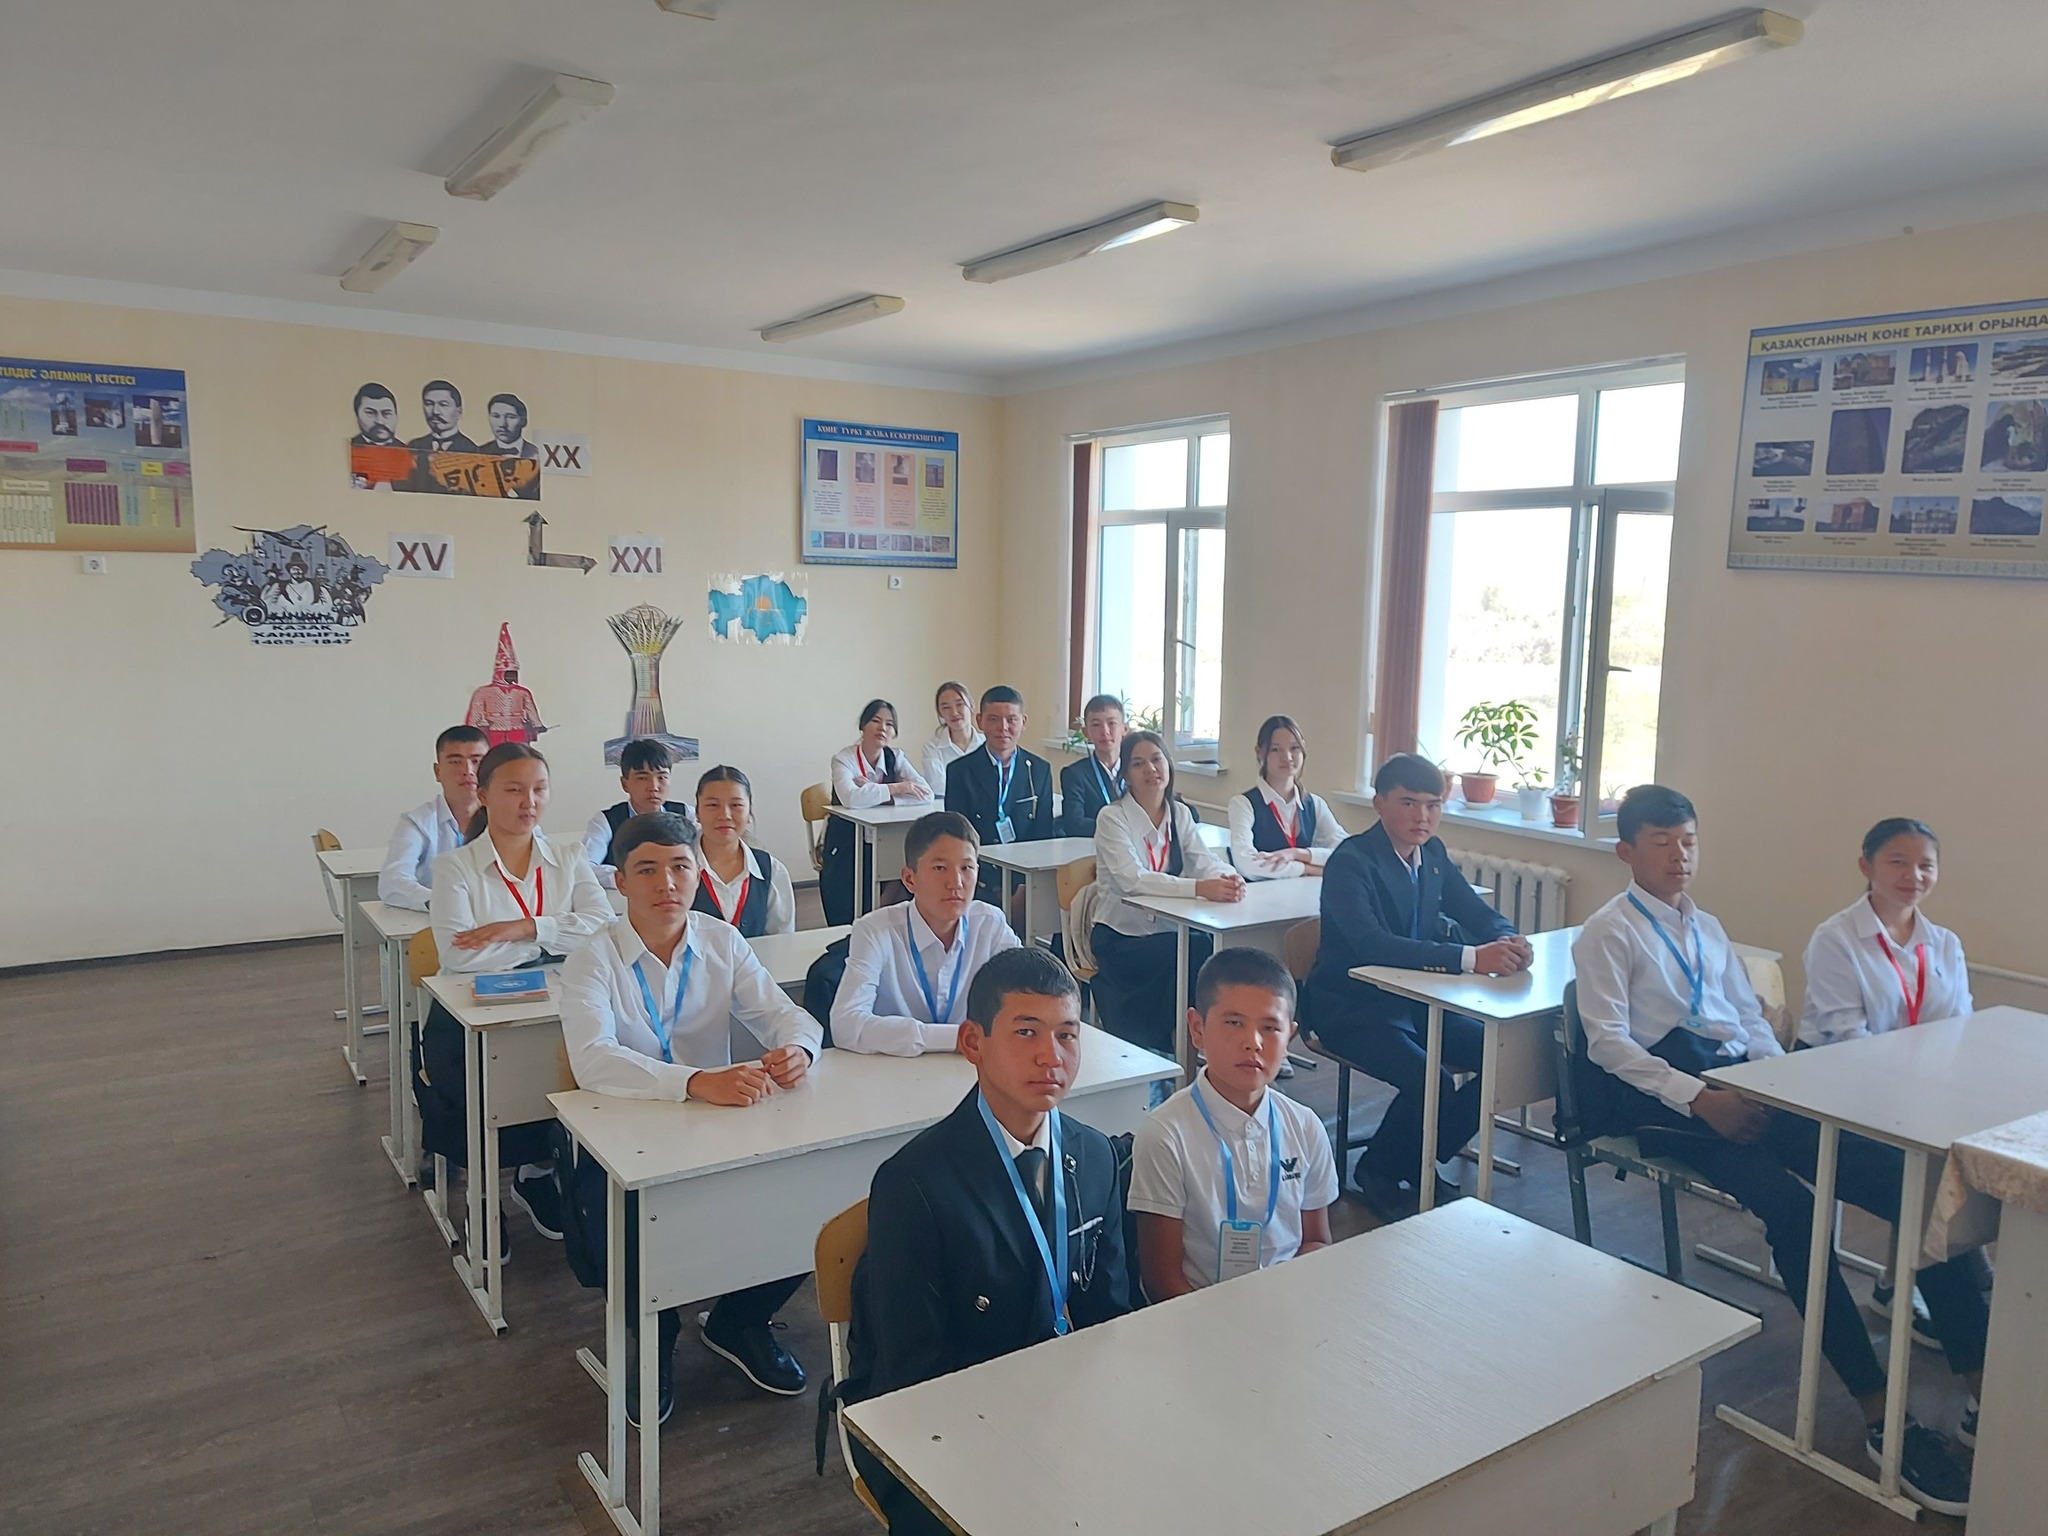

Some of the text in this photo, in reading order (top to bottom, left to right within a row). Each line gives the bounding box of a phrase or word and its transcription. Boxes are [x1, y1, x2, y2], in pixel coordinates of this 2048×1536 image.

[1915, 321, 1974, 337] ТАРИХИ
[542, 444, 582, 469] XX
[396, 541, 449, 571] XV
[610, 546, 663, 573] XXI
